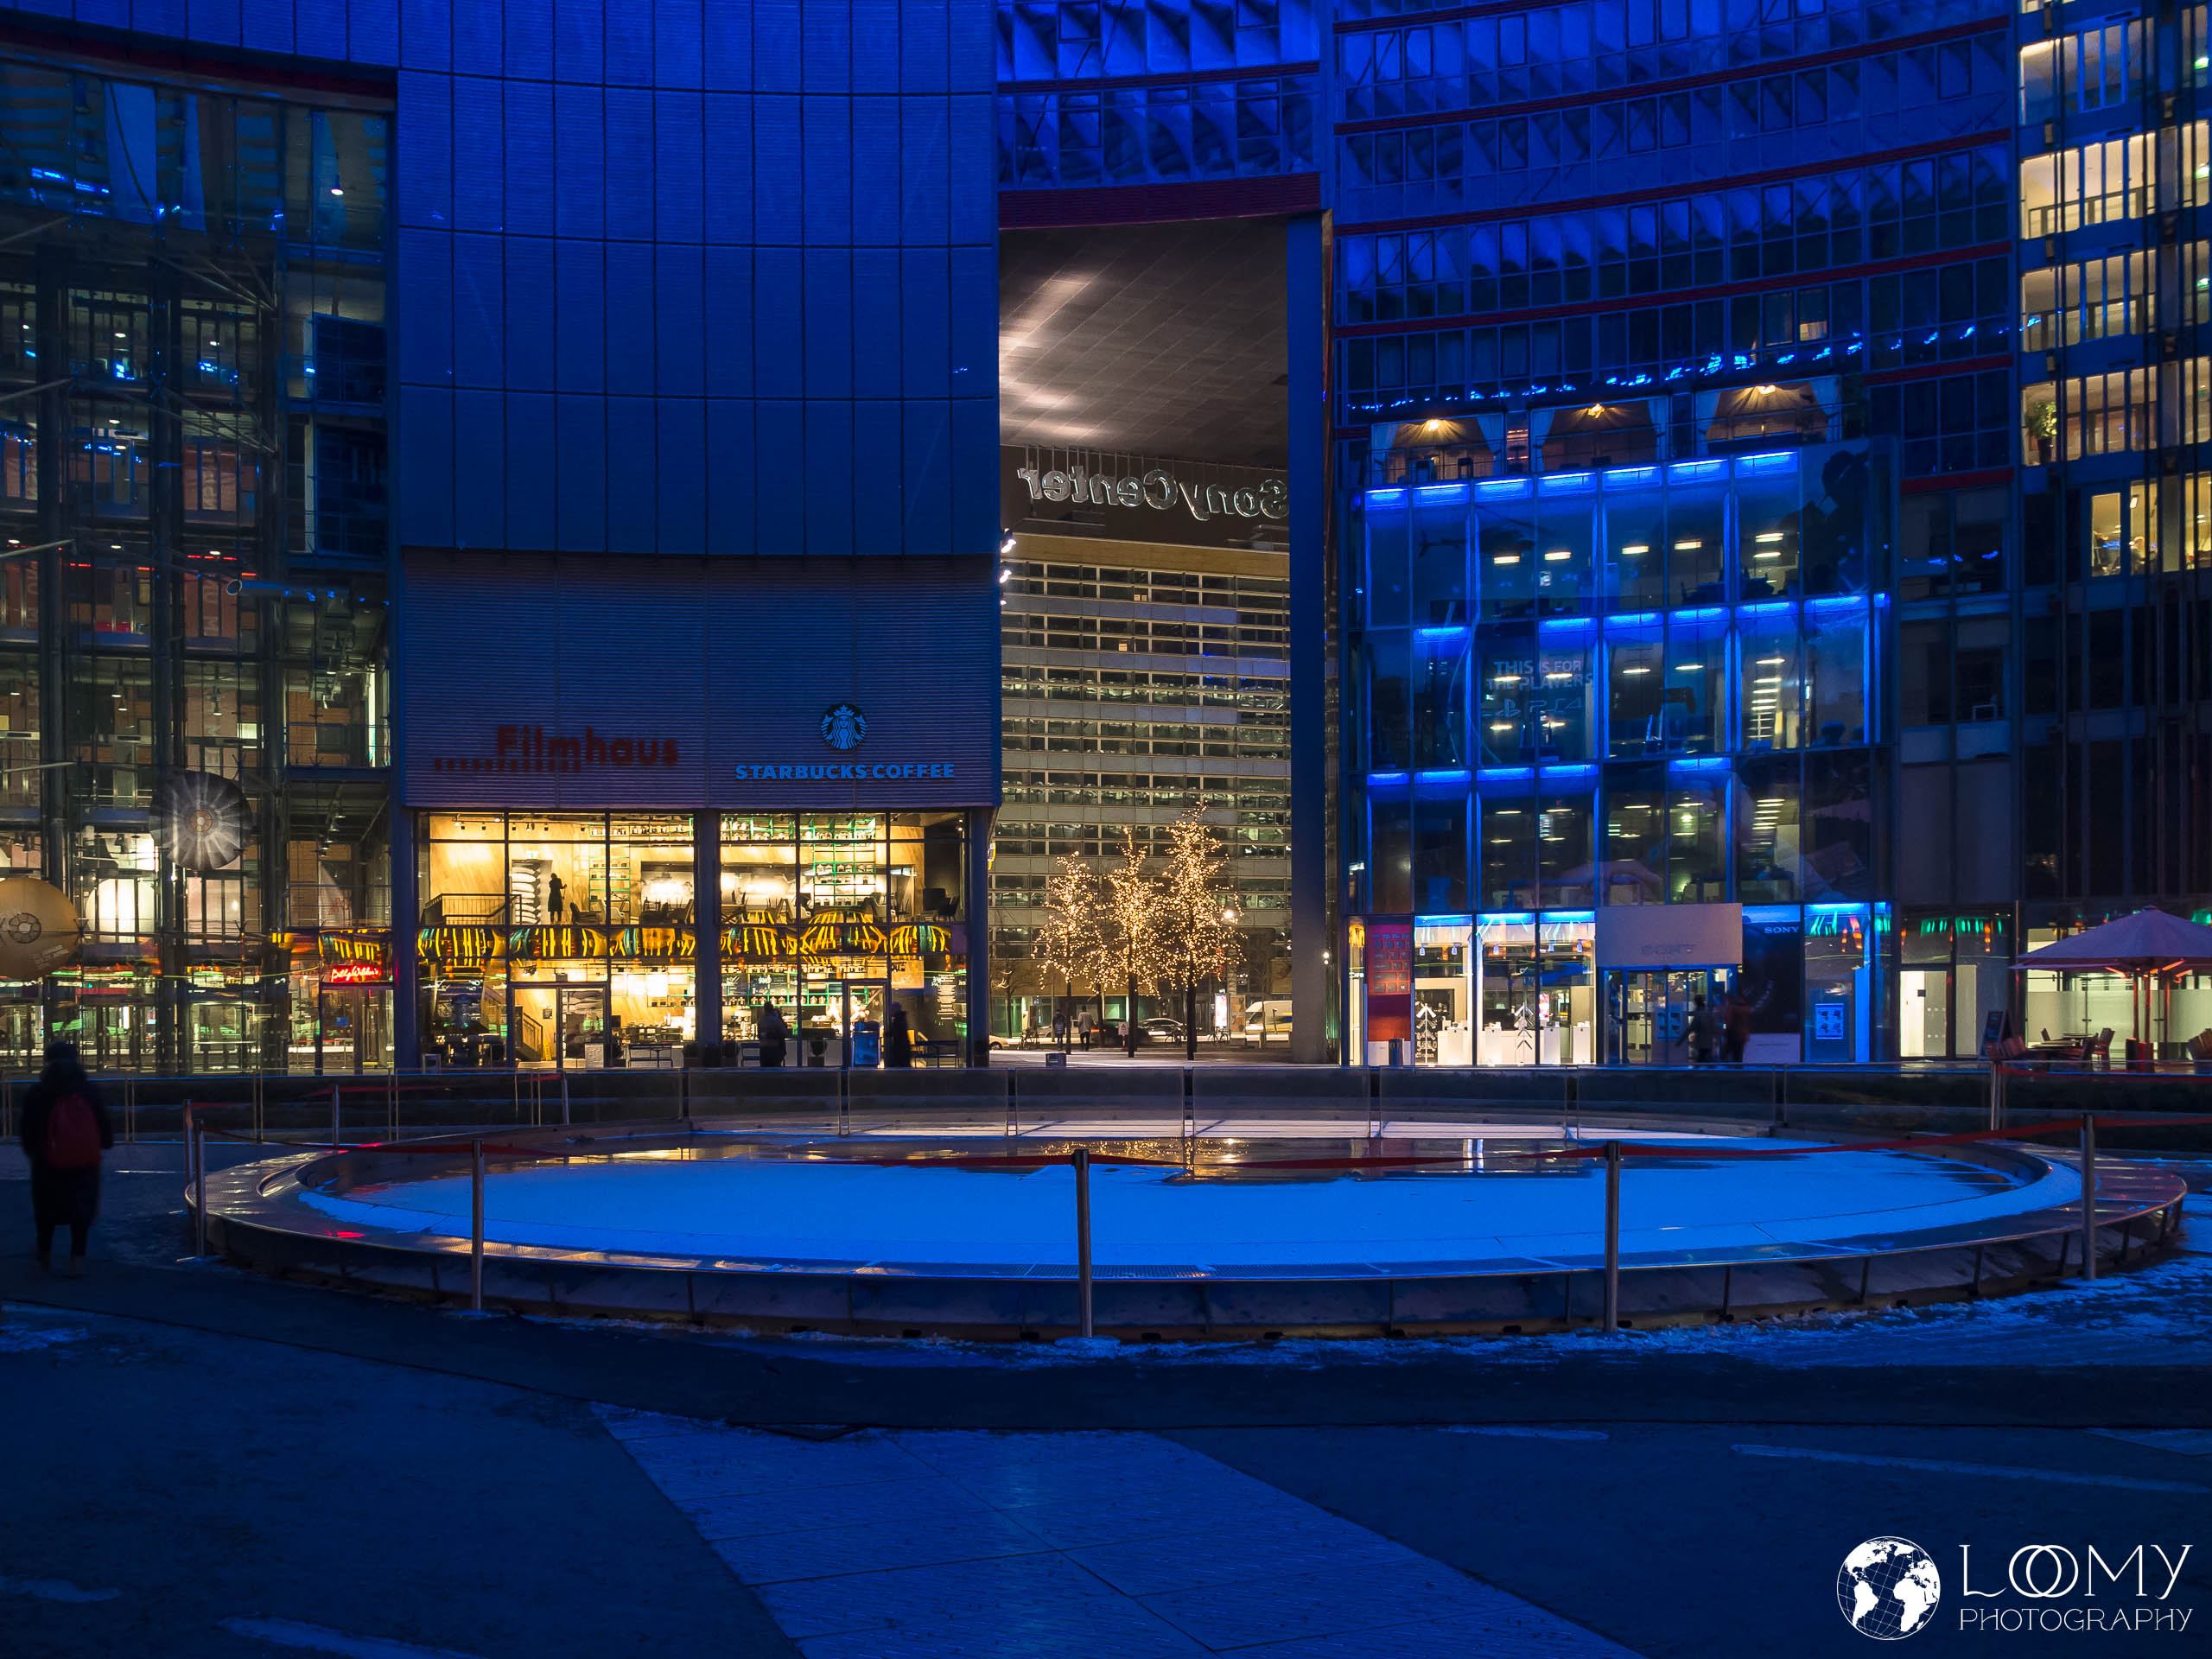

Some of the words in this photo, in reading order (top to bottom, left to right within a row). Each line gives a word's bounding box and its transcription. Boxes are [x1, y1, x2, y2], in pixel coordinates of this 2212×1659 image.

[1492, 659, 1534, 676] THIS
[1554, 659, 1581, 673] FOR
[497, 725, 678, 766] Filmhaus
[735, 764, 868, 779] STARBUCKS
[872, 763, 955, 779] COFFEE
[1764, 925, 1799, 934] SONY
